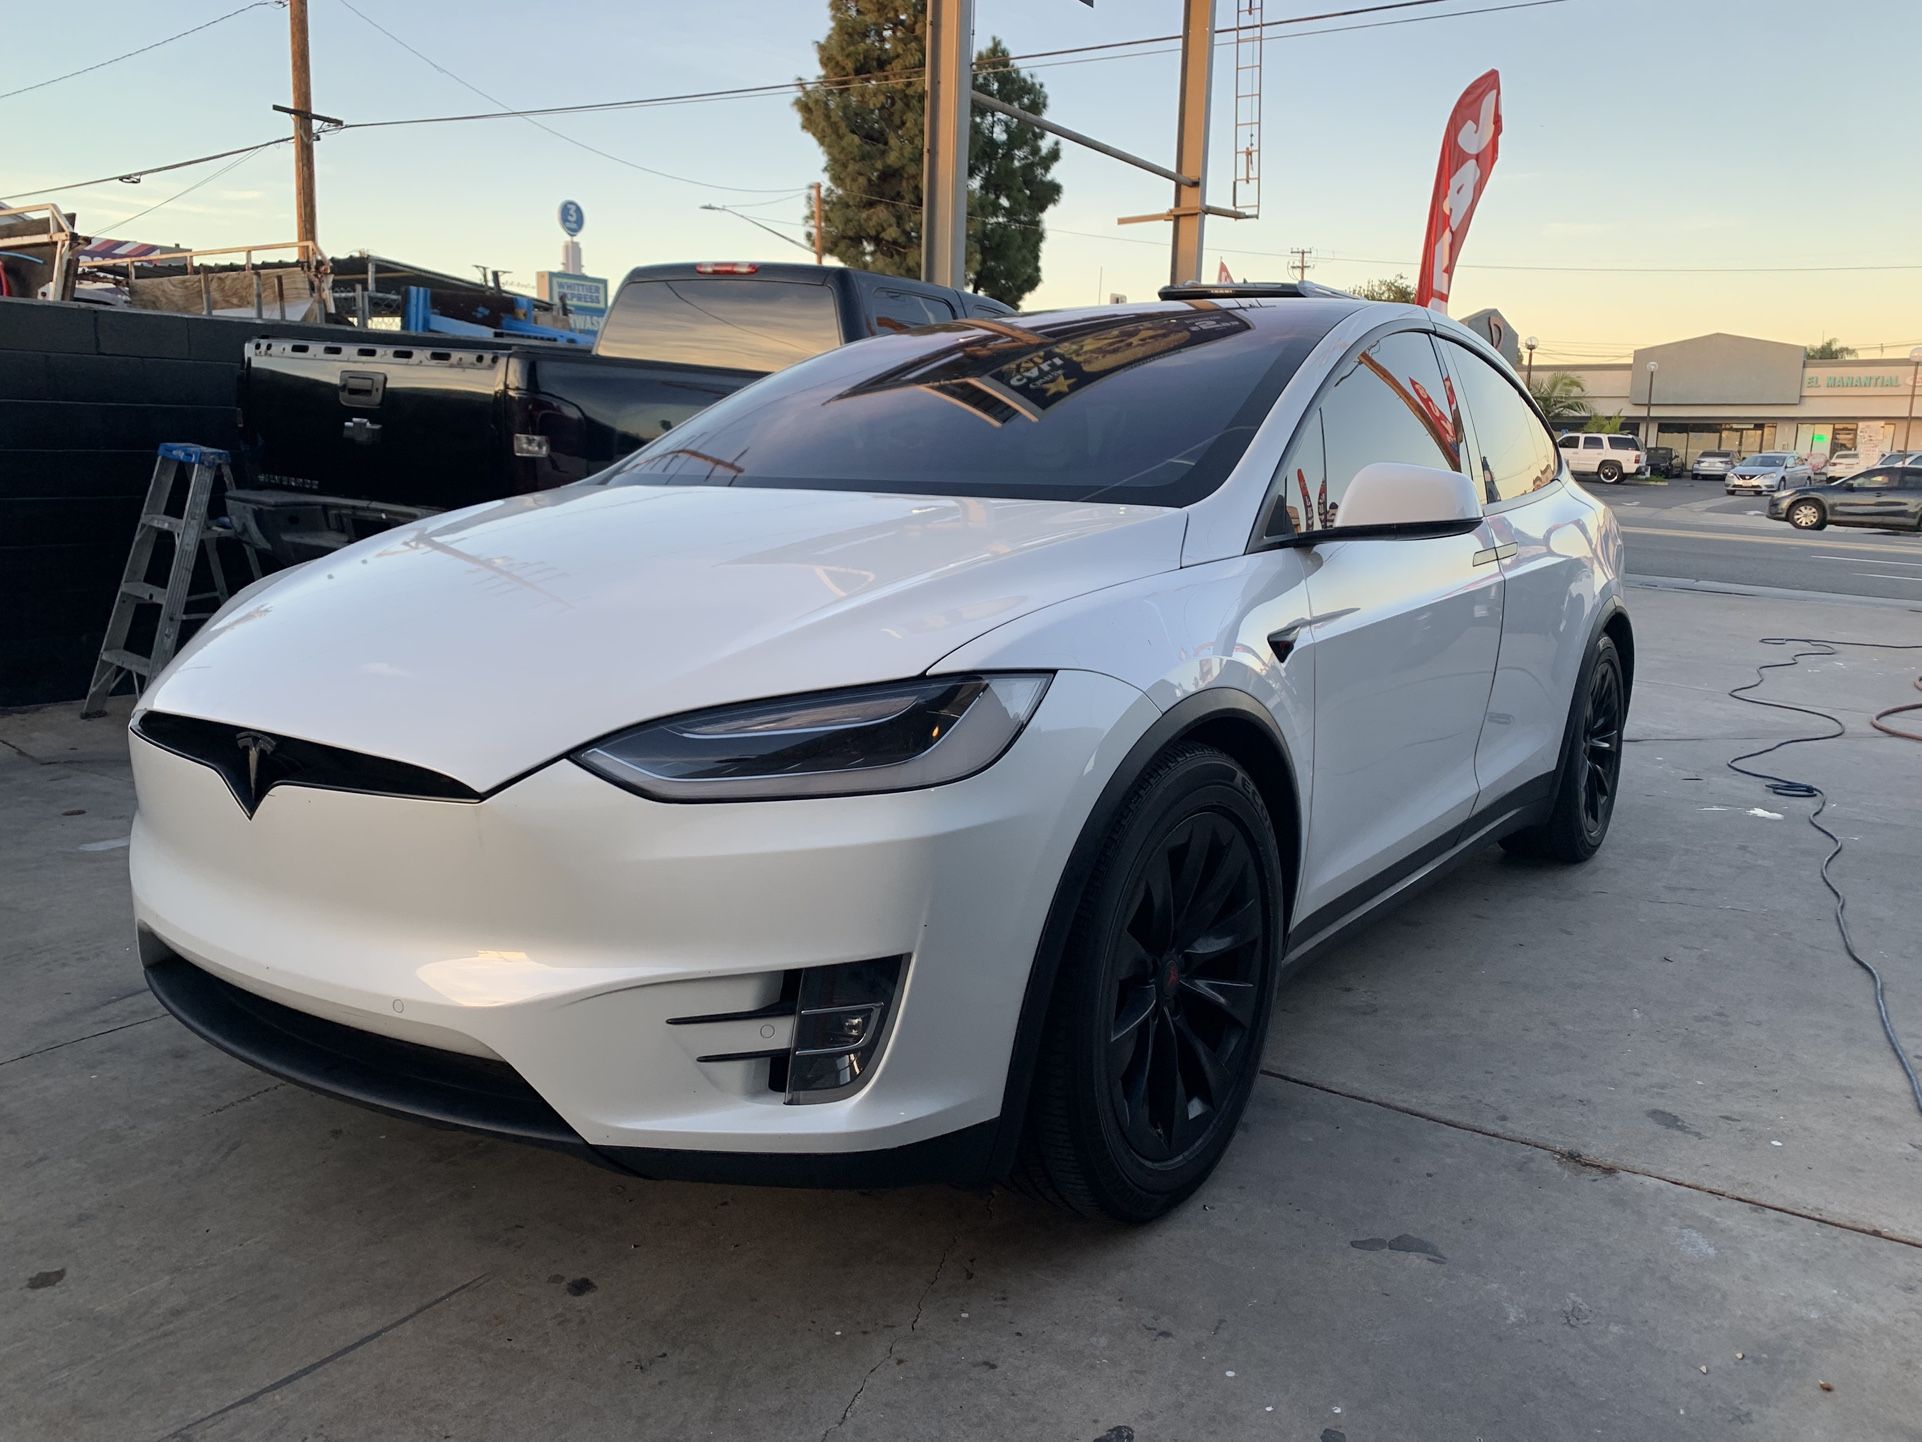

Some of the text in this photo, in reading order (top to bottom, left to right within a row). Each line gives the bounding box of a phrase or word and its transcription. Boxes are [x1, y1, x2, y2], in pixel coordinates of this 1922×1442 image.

[566, 204, 577, 221] 3
[557, 281, 601, 295] WHITTIER
[1806, 375, 1820, 388] EL
[1825, 375, 1901, 388] MANANTIAL
